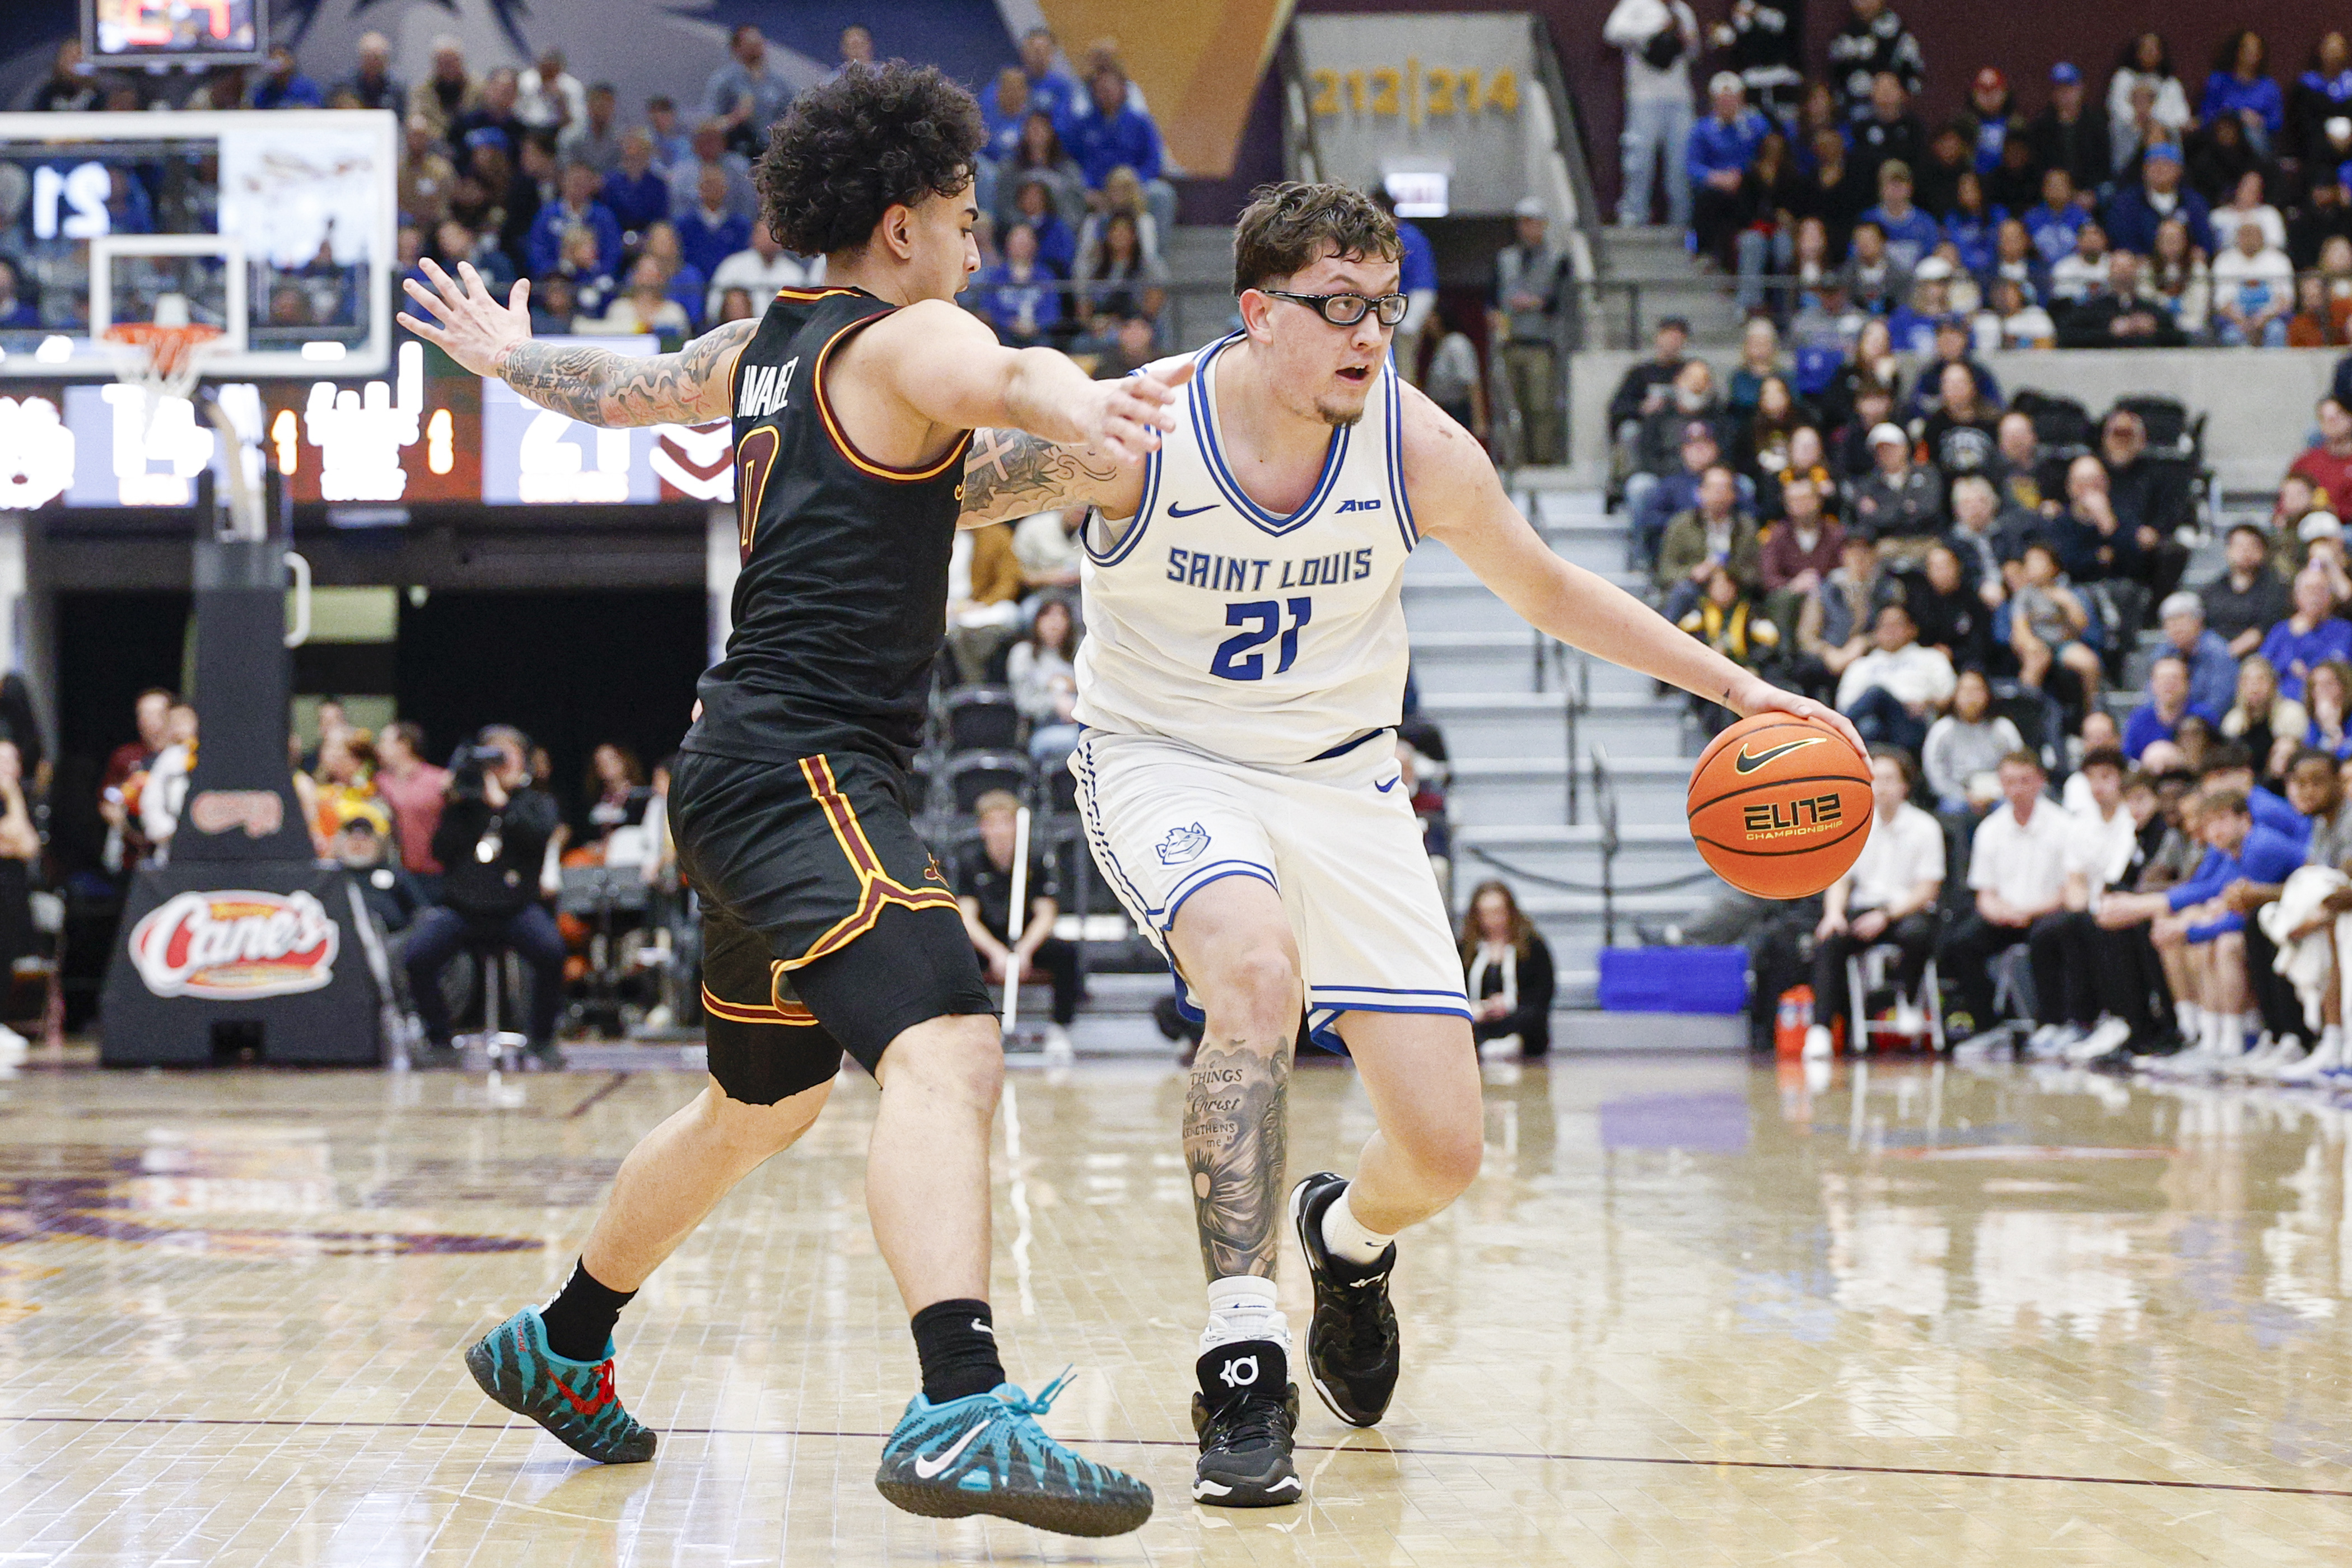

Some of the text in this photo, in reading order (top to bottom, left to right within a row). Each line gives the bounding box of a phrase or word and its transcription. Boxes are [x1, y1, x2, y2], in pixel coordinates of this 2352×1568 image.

[1313, 66, 1519, 115] 212 214
[1334, 499, 1381, 514] A10
[1166, 544, 1374, 592] SAINT LOUIS
[1208, 596, 1312, 681] 21
[1743, 792, 1842, 831] ELITE
[1746, 820, 1844, 841] CHAMPIONSHIP
[1191, 1069, 1243, 1085] THINGS
[1192, 1095, 1241, 1113] Christ
